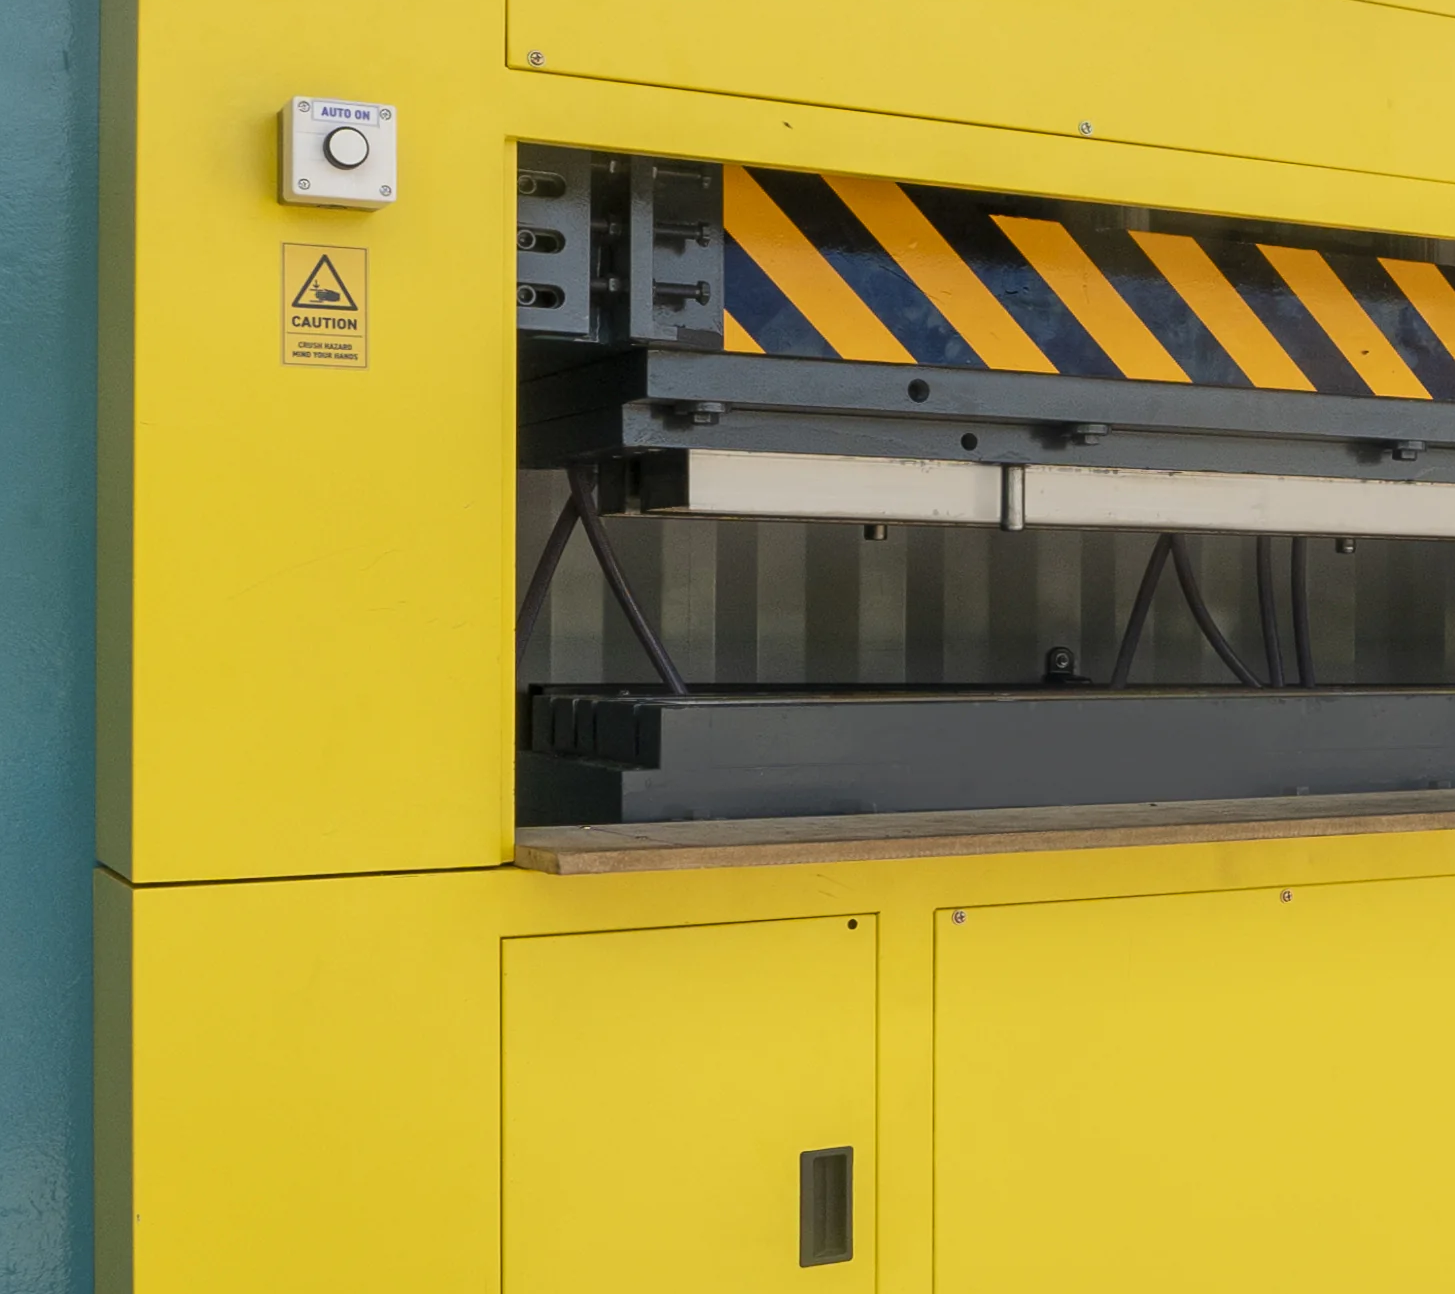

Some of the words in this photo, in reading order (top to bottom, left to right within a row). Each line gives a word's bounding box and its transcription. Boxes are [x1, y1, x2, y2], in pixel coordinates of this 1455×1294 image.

[321, 106, 351, 119] AUTO
[354, 110, 370, 121] ON
[291, 315, 358, 331] CAUTION
[297, 341, 323, 349] CRUSH
[324, 342, 353, 351] HAZARD
[313, 351, 333, 359] YOUR
